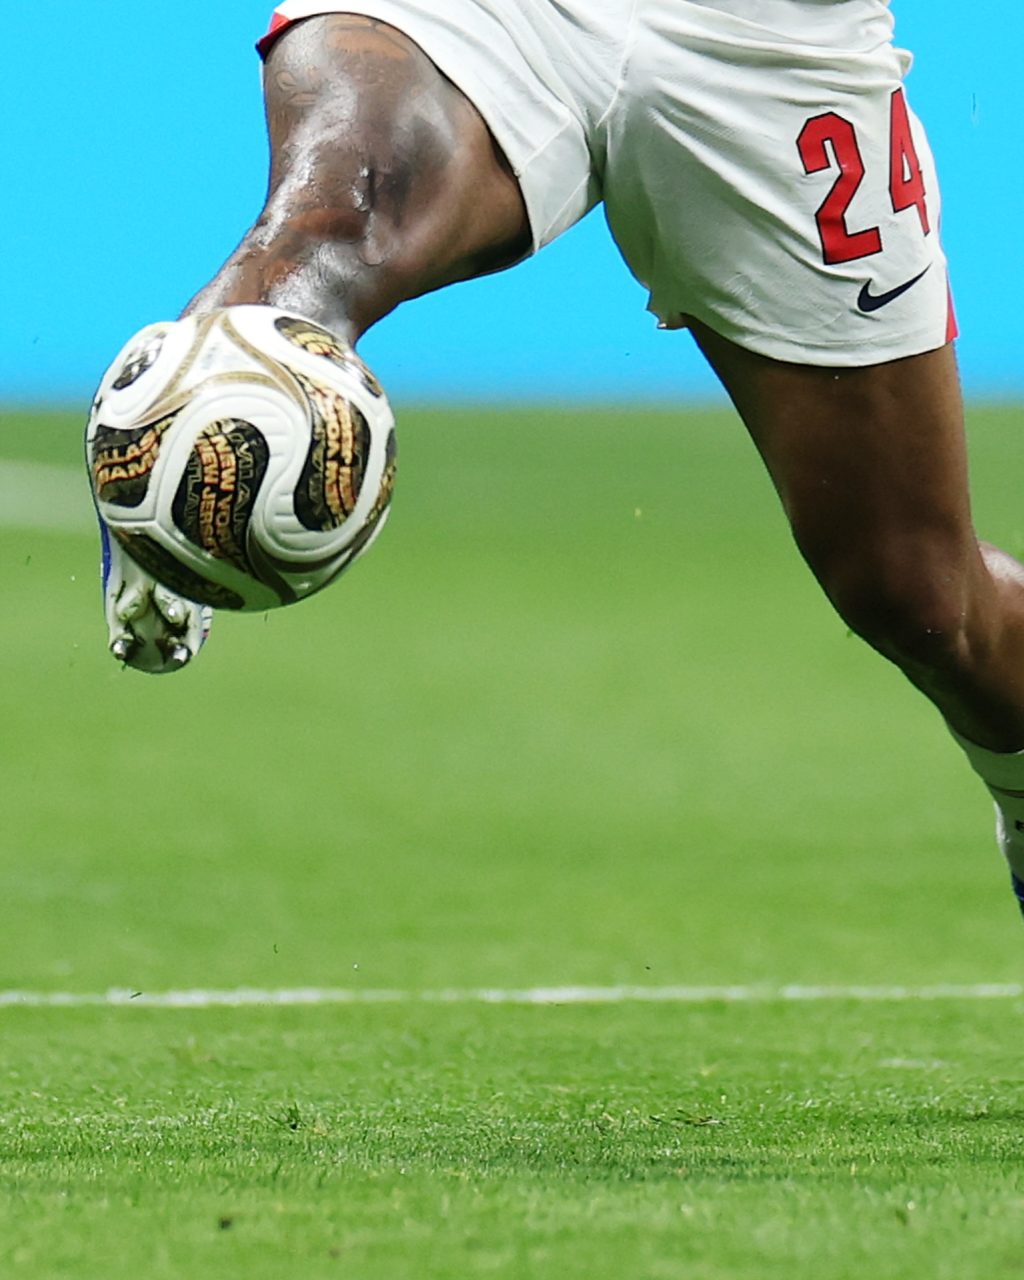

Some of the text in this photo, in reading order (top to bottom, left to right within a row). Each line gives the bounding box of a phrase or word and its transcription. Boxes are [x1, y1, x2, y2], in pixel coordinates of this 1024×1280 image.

[796, 87, 931, 266] 24
[195, 437, 220, 485] NEW
[209, 434, 236, 492] NEW
